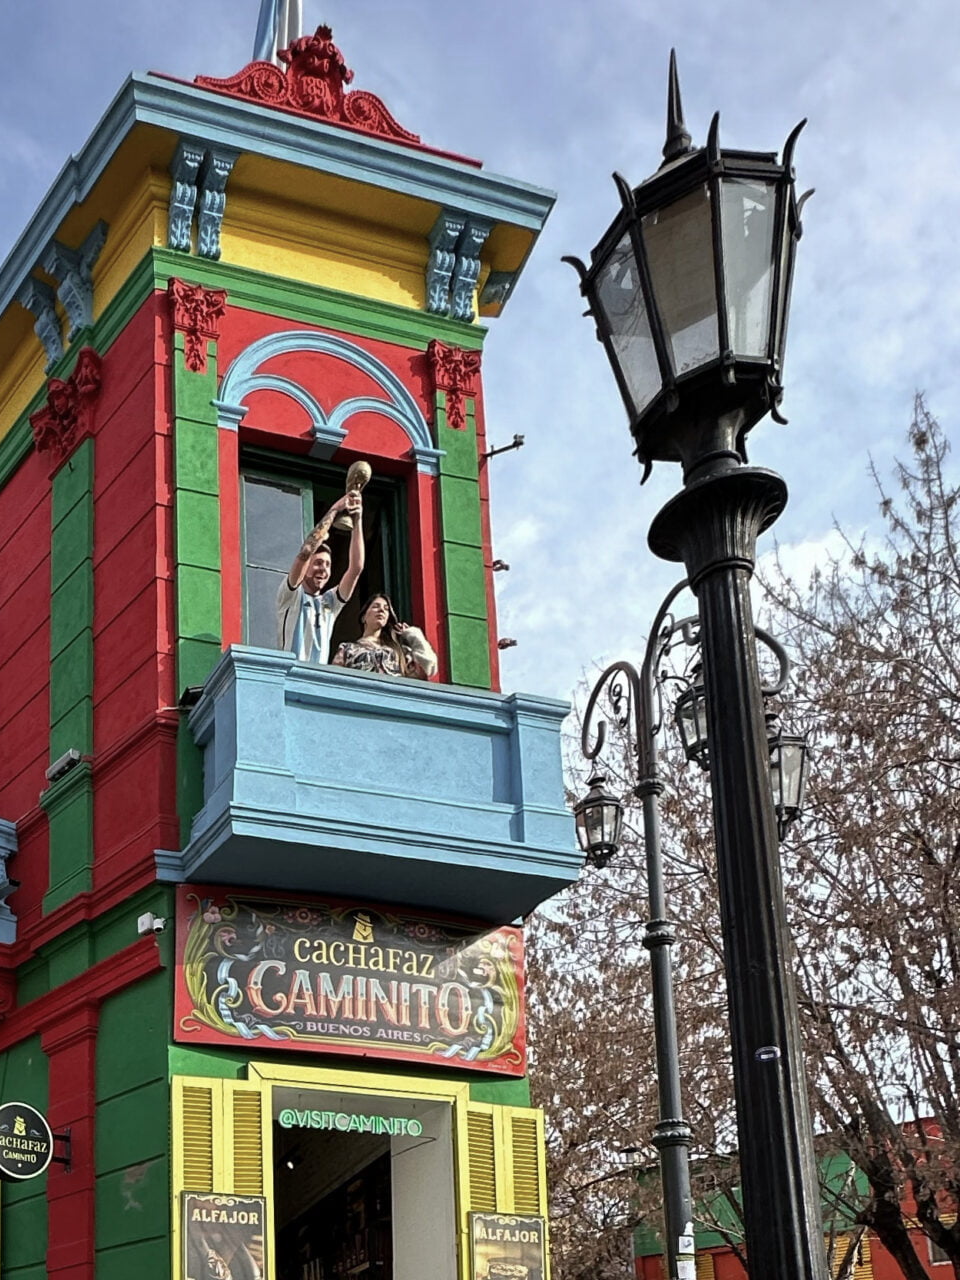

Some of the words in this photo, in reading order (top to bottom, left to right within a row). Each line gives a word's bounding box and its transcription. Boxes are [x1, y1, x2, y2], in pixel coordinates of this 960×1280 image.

[246, 959, 472, 1035] CAMINITO
[306, 1020, 372, 1038] BUENOS
[376, 1027, 422, 1044] AIRES
[278, 1108, 423, 1137] @VISITCAMINITO
[3, 1149, 37, 1163] CAMINITO
[192, 1208, 259, 1225] ALFAJOR
[480, 1228, 539, 1243] ALFAJOR
